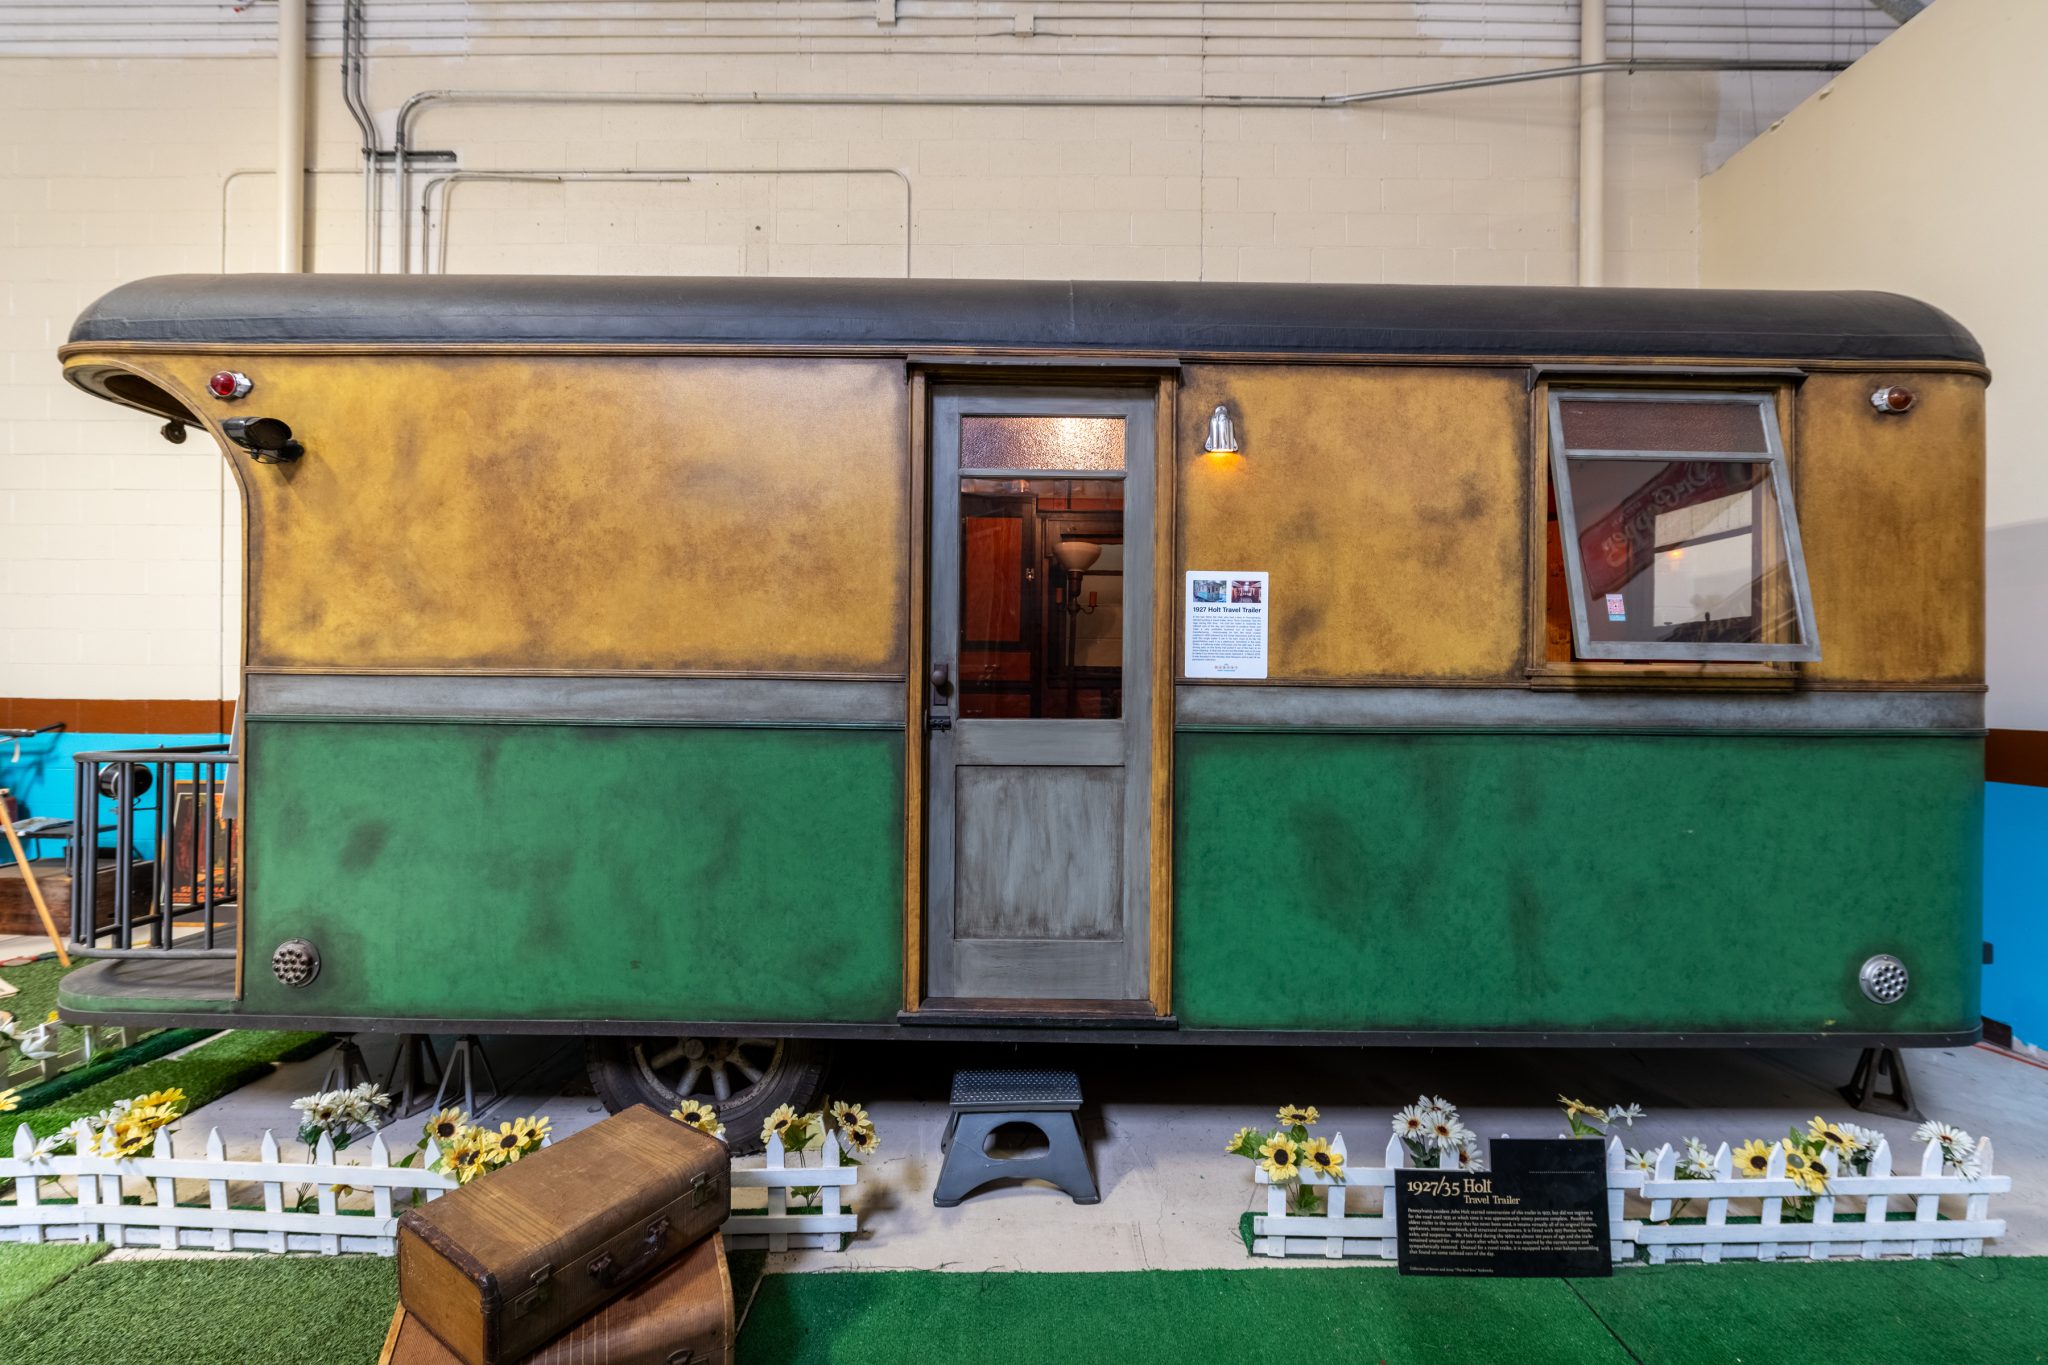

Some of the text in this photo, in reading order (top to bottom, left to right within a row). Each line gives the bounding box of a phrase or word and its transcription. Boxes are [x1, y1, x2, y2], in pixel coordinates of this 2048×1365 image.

[1407, 1176, 1493, 1197] 1927/35 Holt
[1463, 1194, 1520, 1205] Travel Trailer
